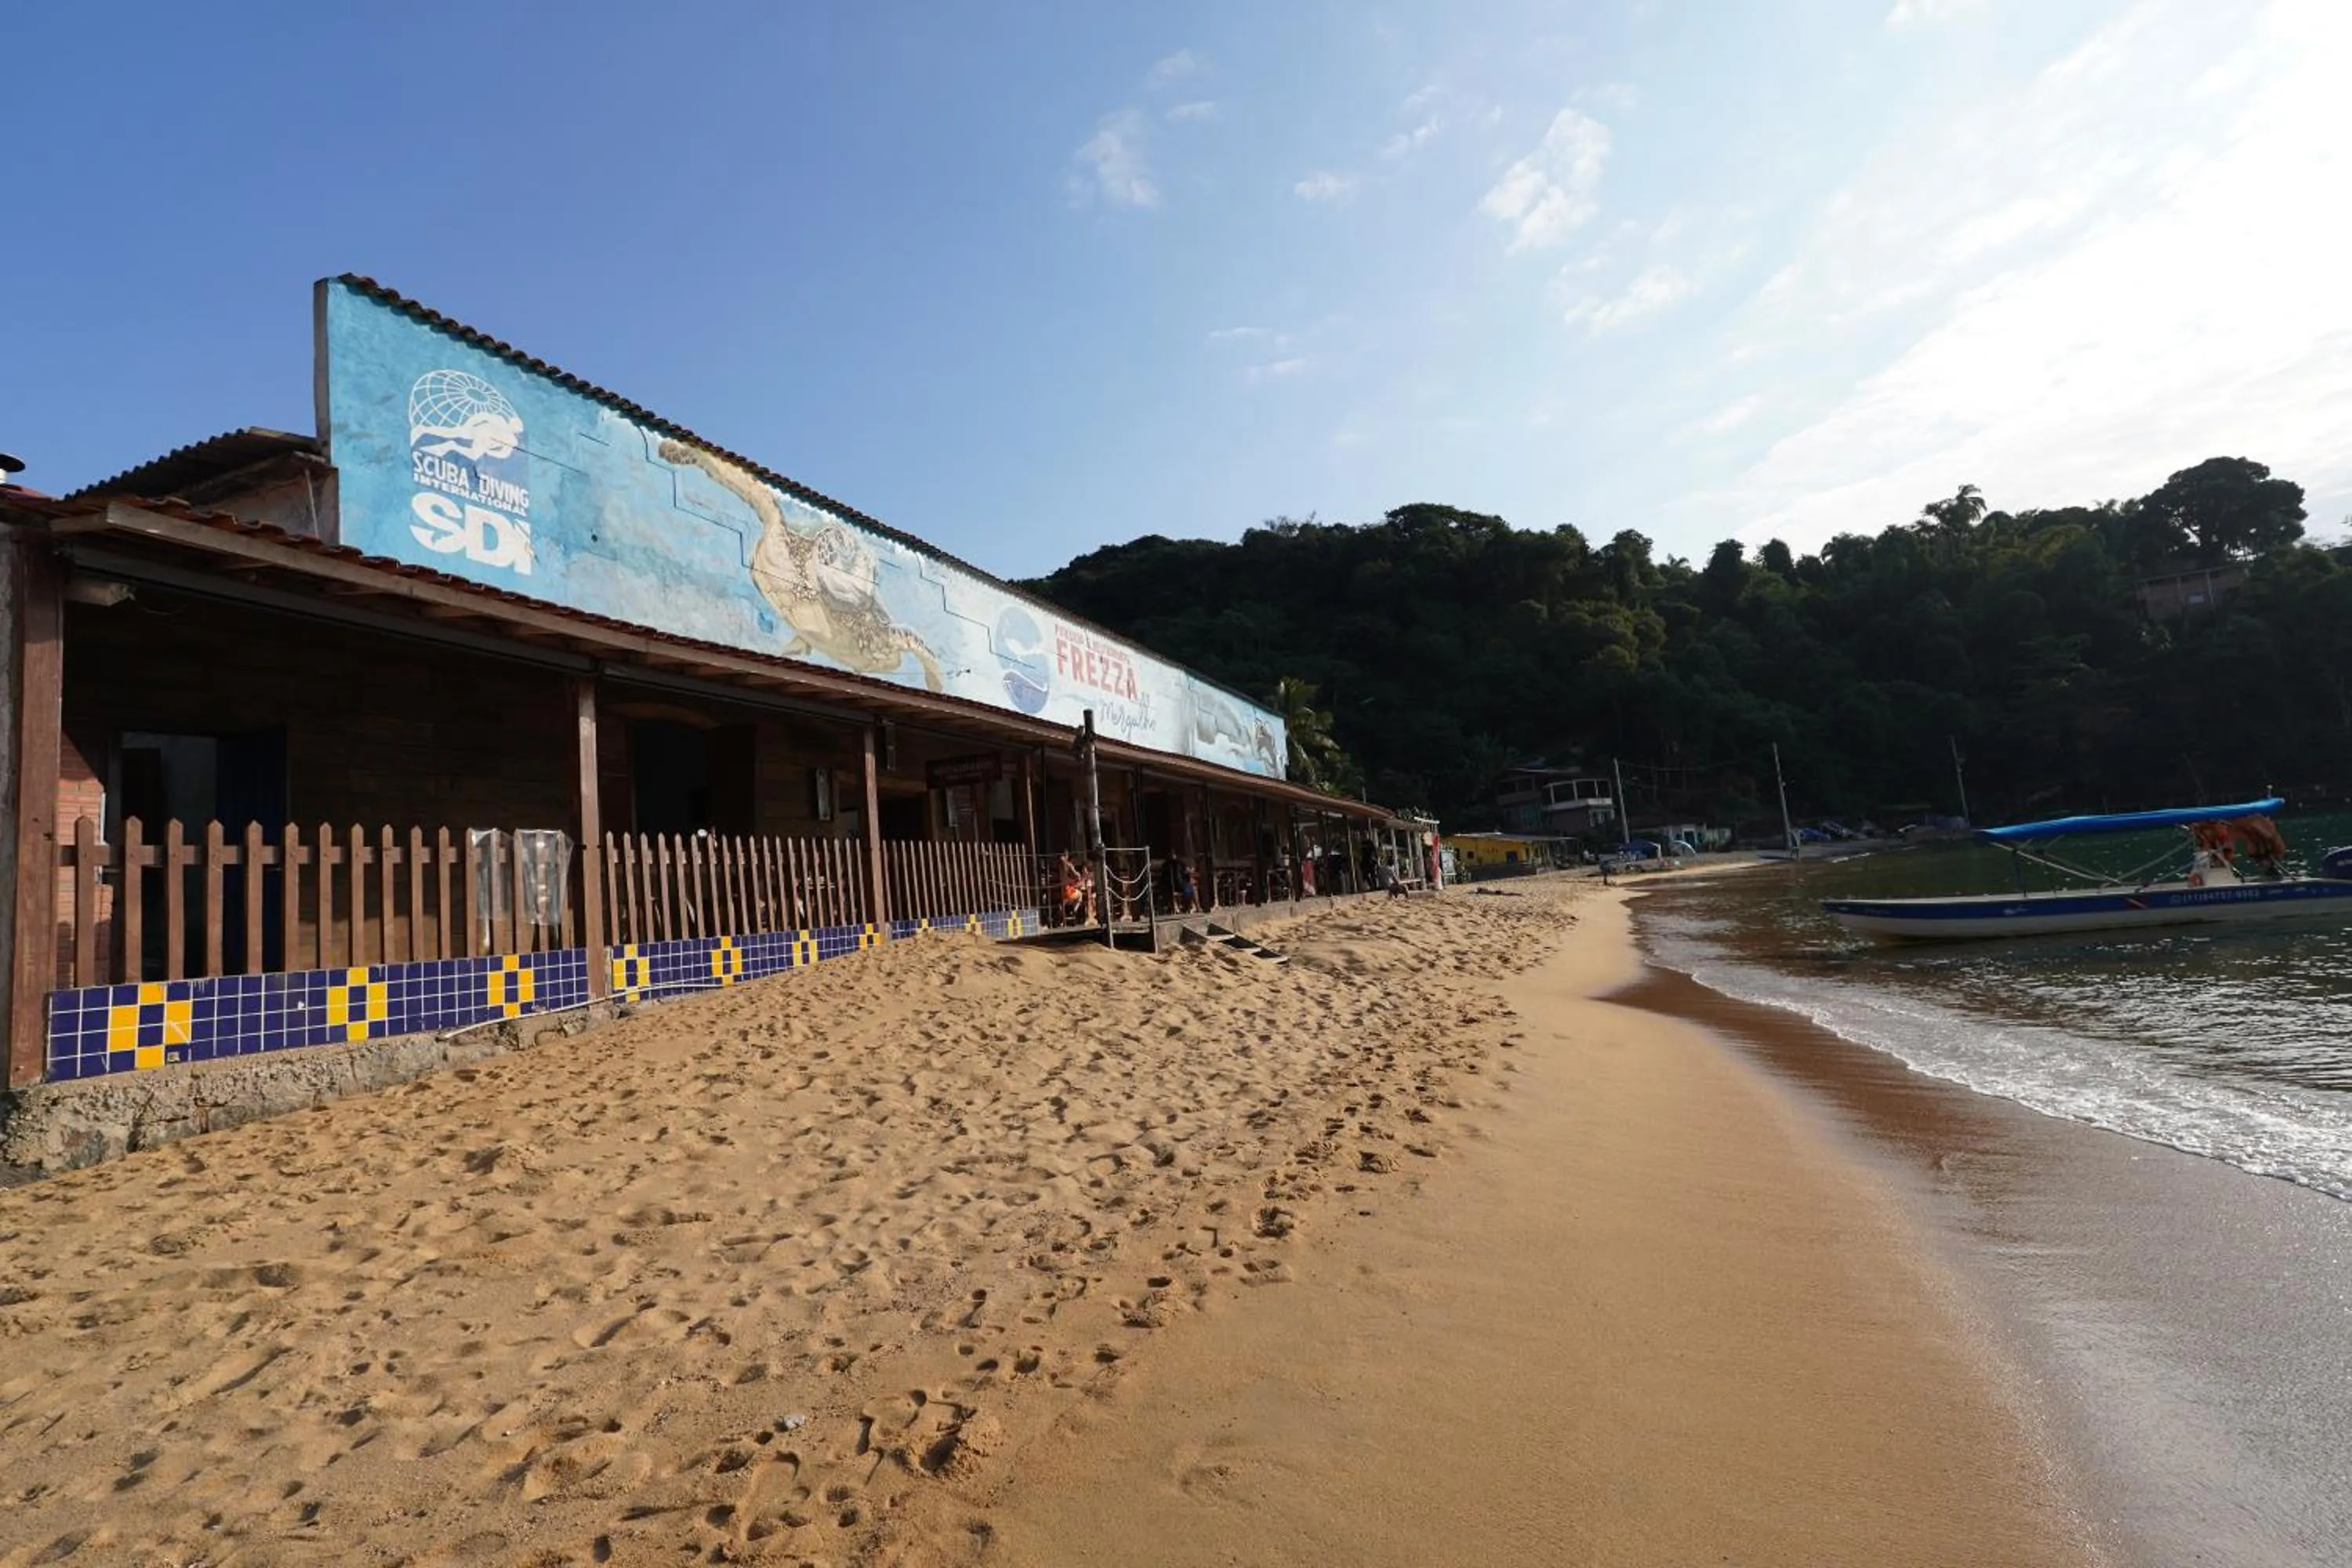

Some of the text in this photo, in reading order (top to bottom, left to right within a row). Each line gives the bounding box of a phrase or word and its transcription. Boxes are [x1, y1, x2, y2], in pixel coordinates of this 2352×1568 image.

[412, 452, 530, 509] SCUBA DIVING
[413, 473, 527, 517] INTERNATIONAL
[1055, 637, 1138, 701] FREZZA
